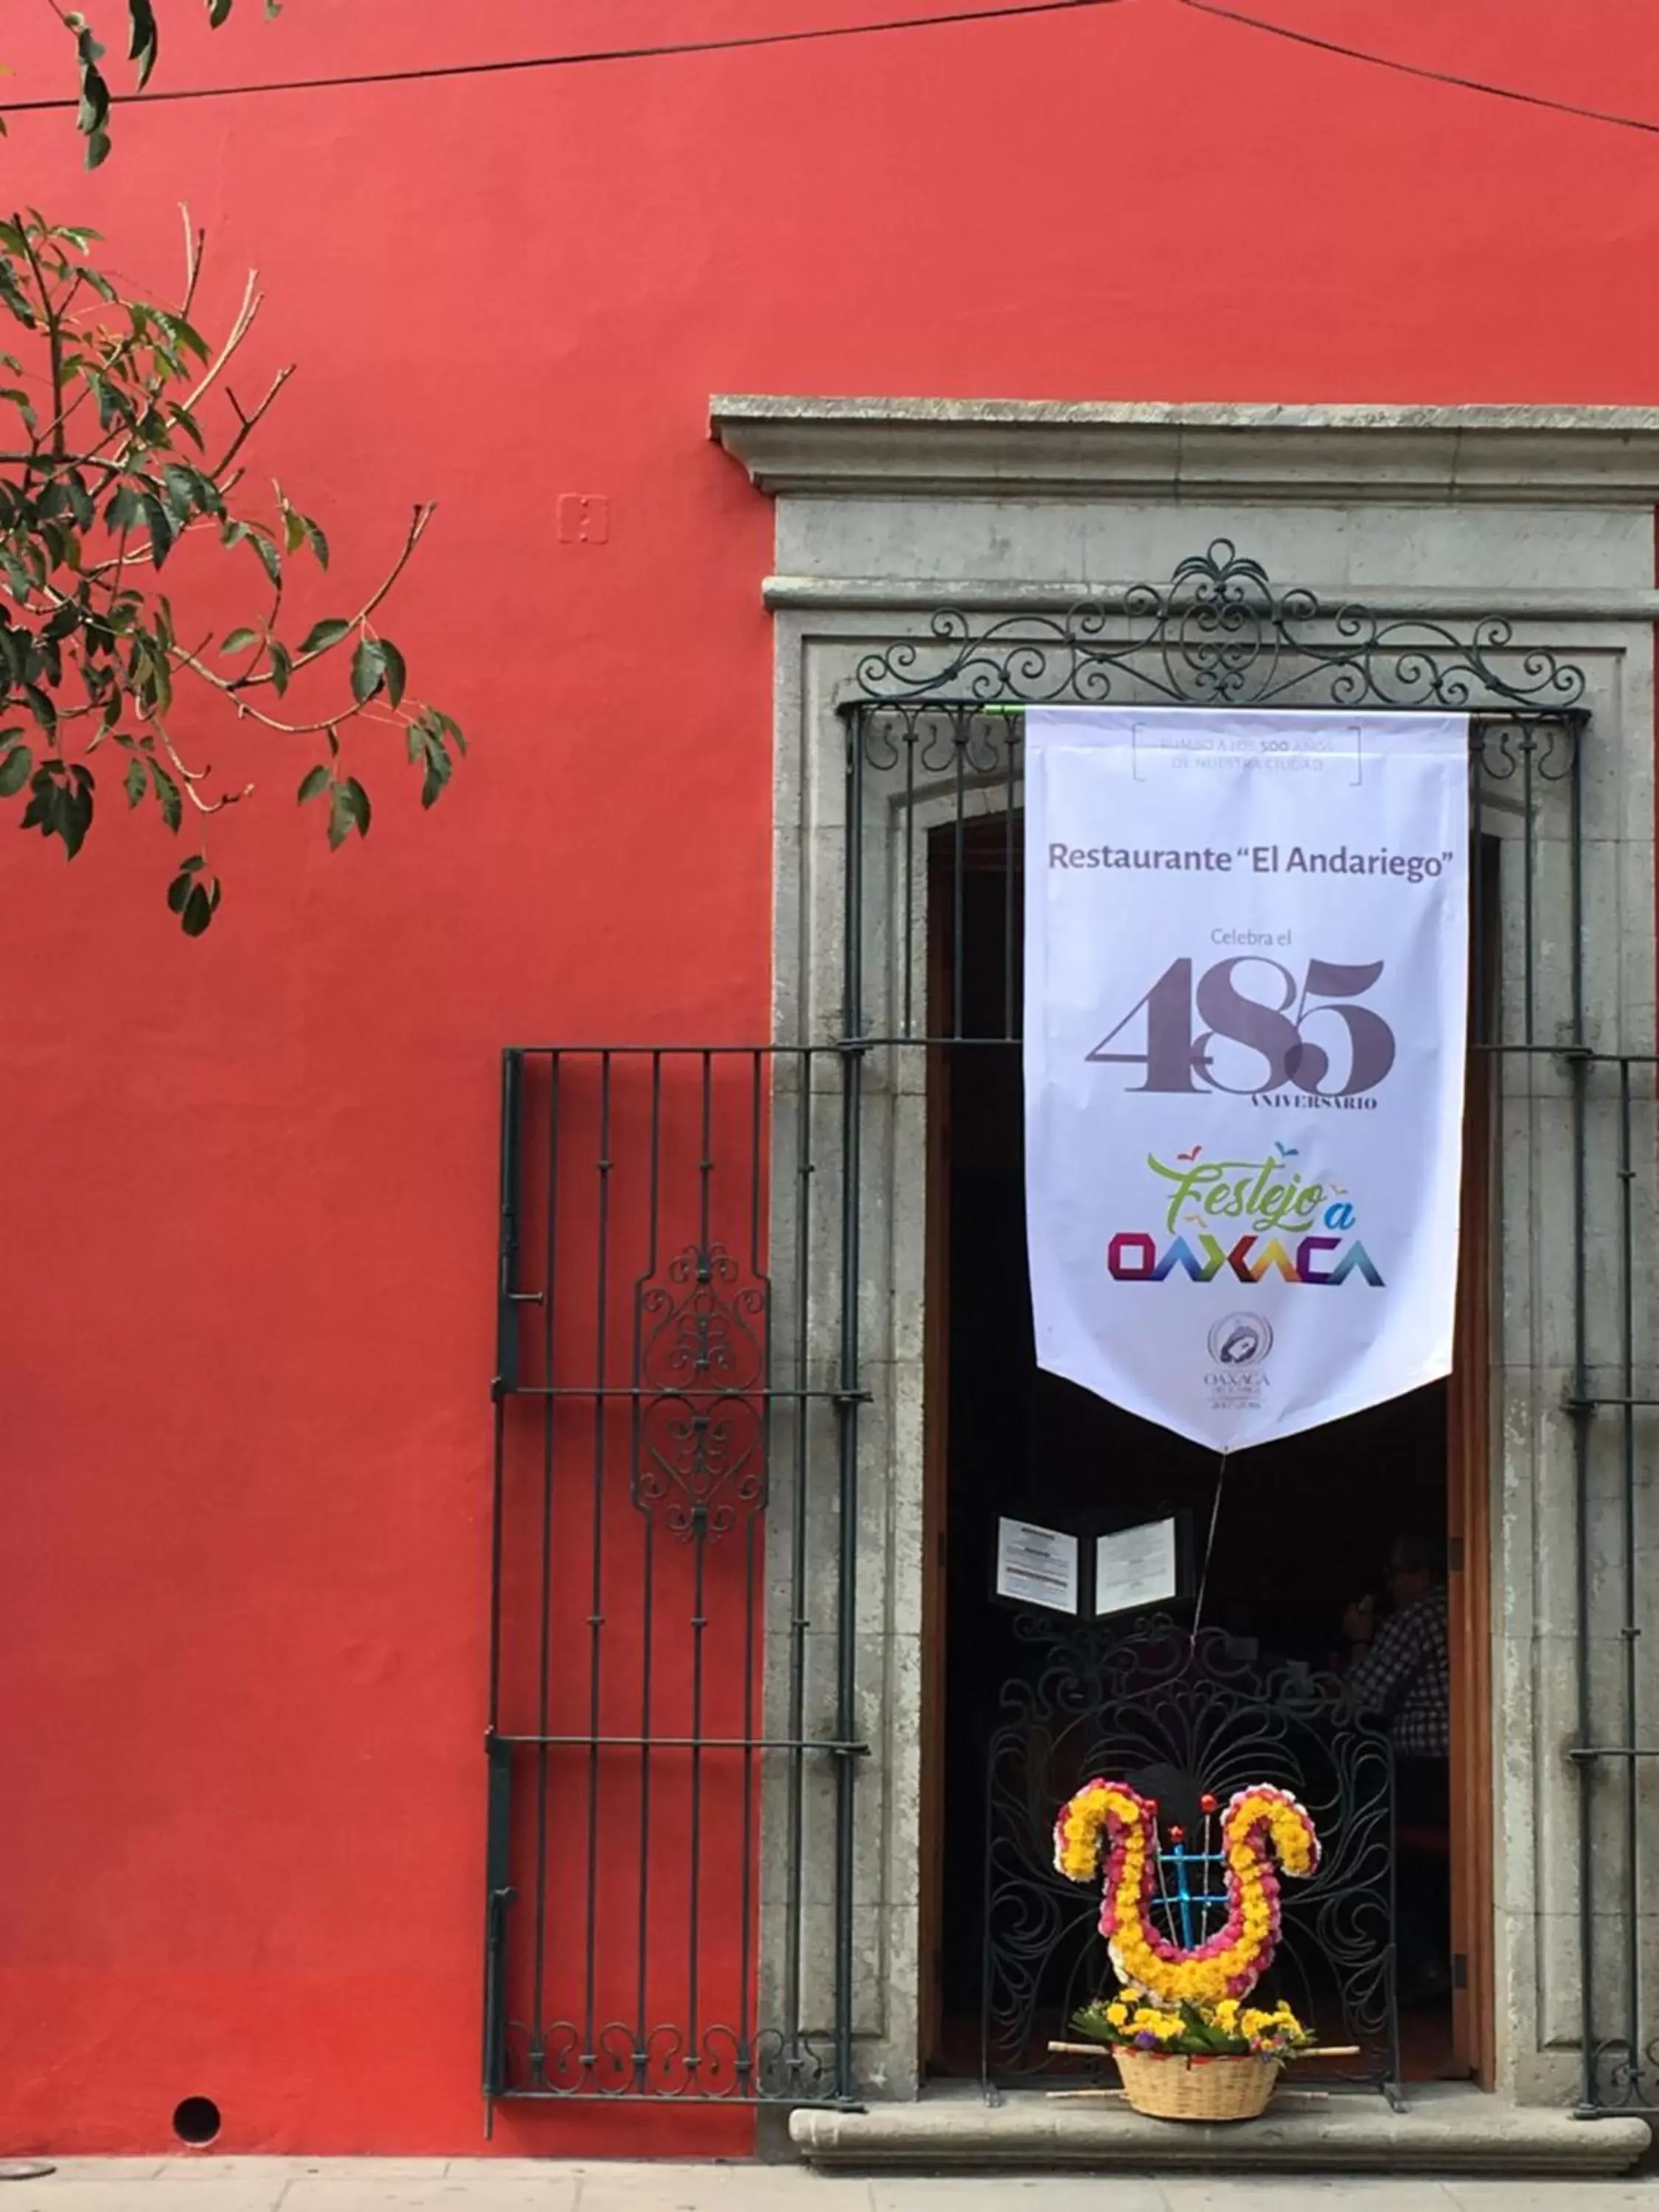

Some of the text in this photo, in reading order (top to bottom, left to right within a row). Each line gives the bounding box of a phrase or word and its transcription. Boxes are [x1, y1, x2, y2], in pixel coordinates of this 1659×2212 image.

[1259, 739, 1290, 754] 500
[1048, 842, 1232, 872] Restaurante
[1210, 927, 1293, 947] Celebra el
[1085, 956, 1396, 1097] 485
[1251, 1094, 1378, 1110] ANIVERSARIO
[1147, 1152, 1357, 1235] Festejo a
[1107, 1231, 1387, 1288] OAXACA
